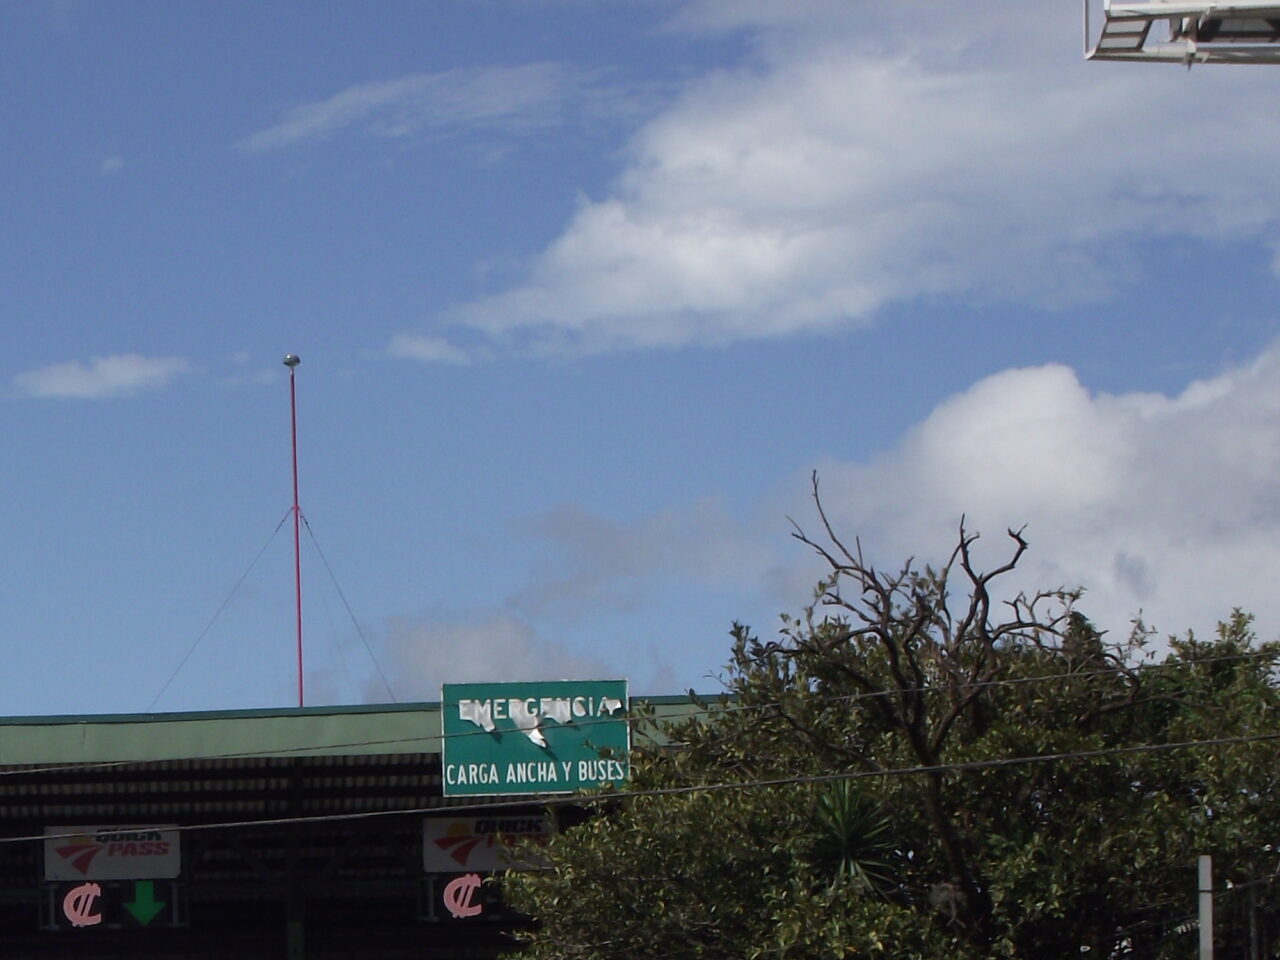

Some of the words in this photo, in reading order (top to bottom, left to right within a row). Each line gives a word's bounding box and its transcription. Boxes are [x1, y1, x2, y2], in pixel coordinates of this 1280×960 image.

[447, 763, 499, 785] CARGA
[506, 761, 558, 783] ANCHA
[562, 761, 572, 781] Y
[578, 760, 625, 781] BUSES
[475, 819, 543, 834] QUICK
[107, 842, 170, 857] PASS
